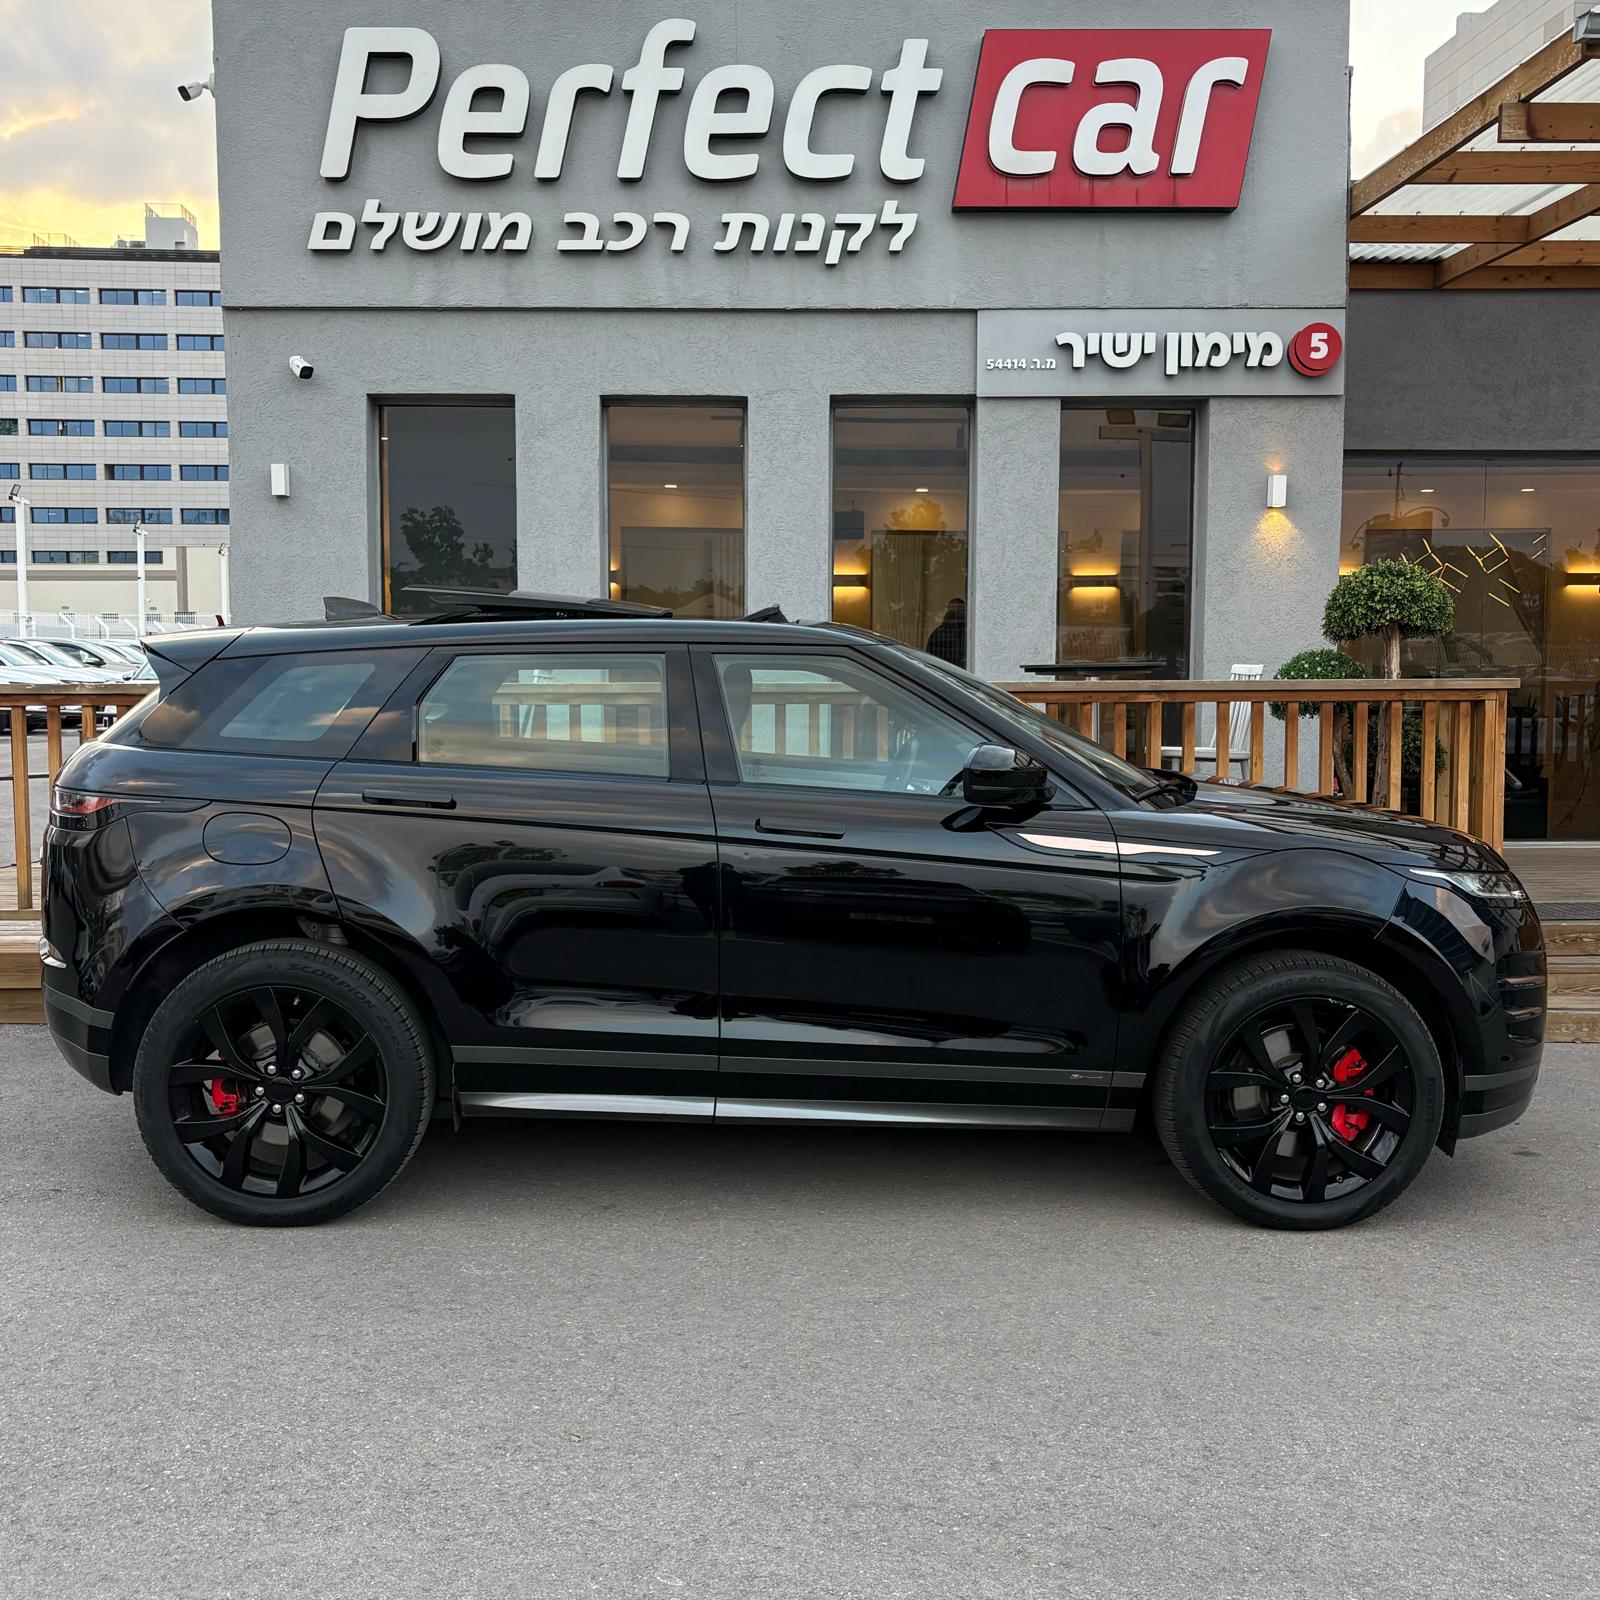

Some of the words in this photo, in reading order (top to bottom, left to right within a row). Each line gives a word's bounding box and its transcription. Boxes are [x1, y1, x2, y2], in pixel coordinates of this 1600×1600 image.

[319, 18, 943, 183] Perfect
[988, 57, 1250, 177] car
[307, 199, 533, 254] מושלם
[557, 211, 690, 253] רכב
[713, 200, 918, 265] לקנות
[986, 358, 1027, 370] 54414
[1055, 331, 1157, 369] ישיר
[1164, 331, 1284, 376] מימון
[1308, 332, 1329, 360] 5
